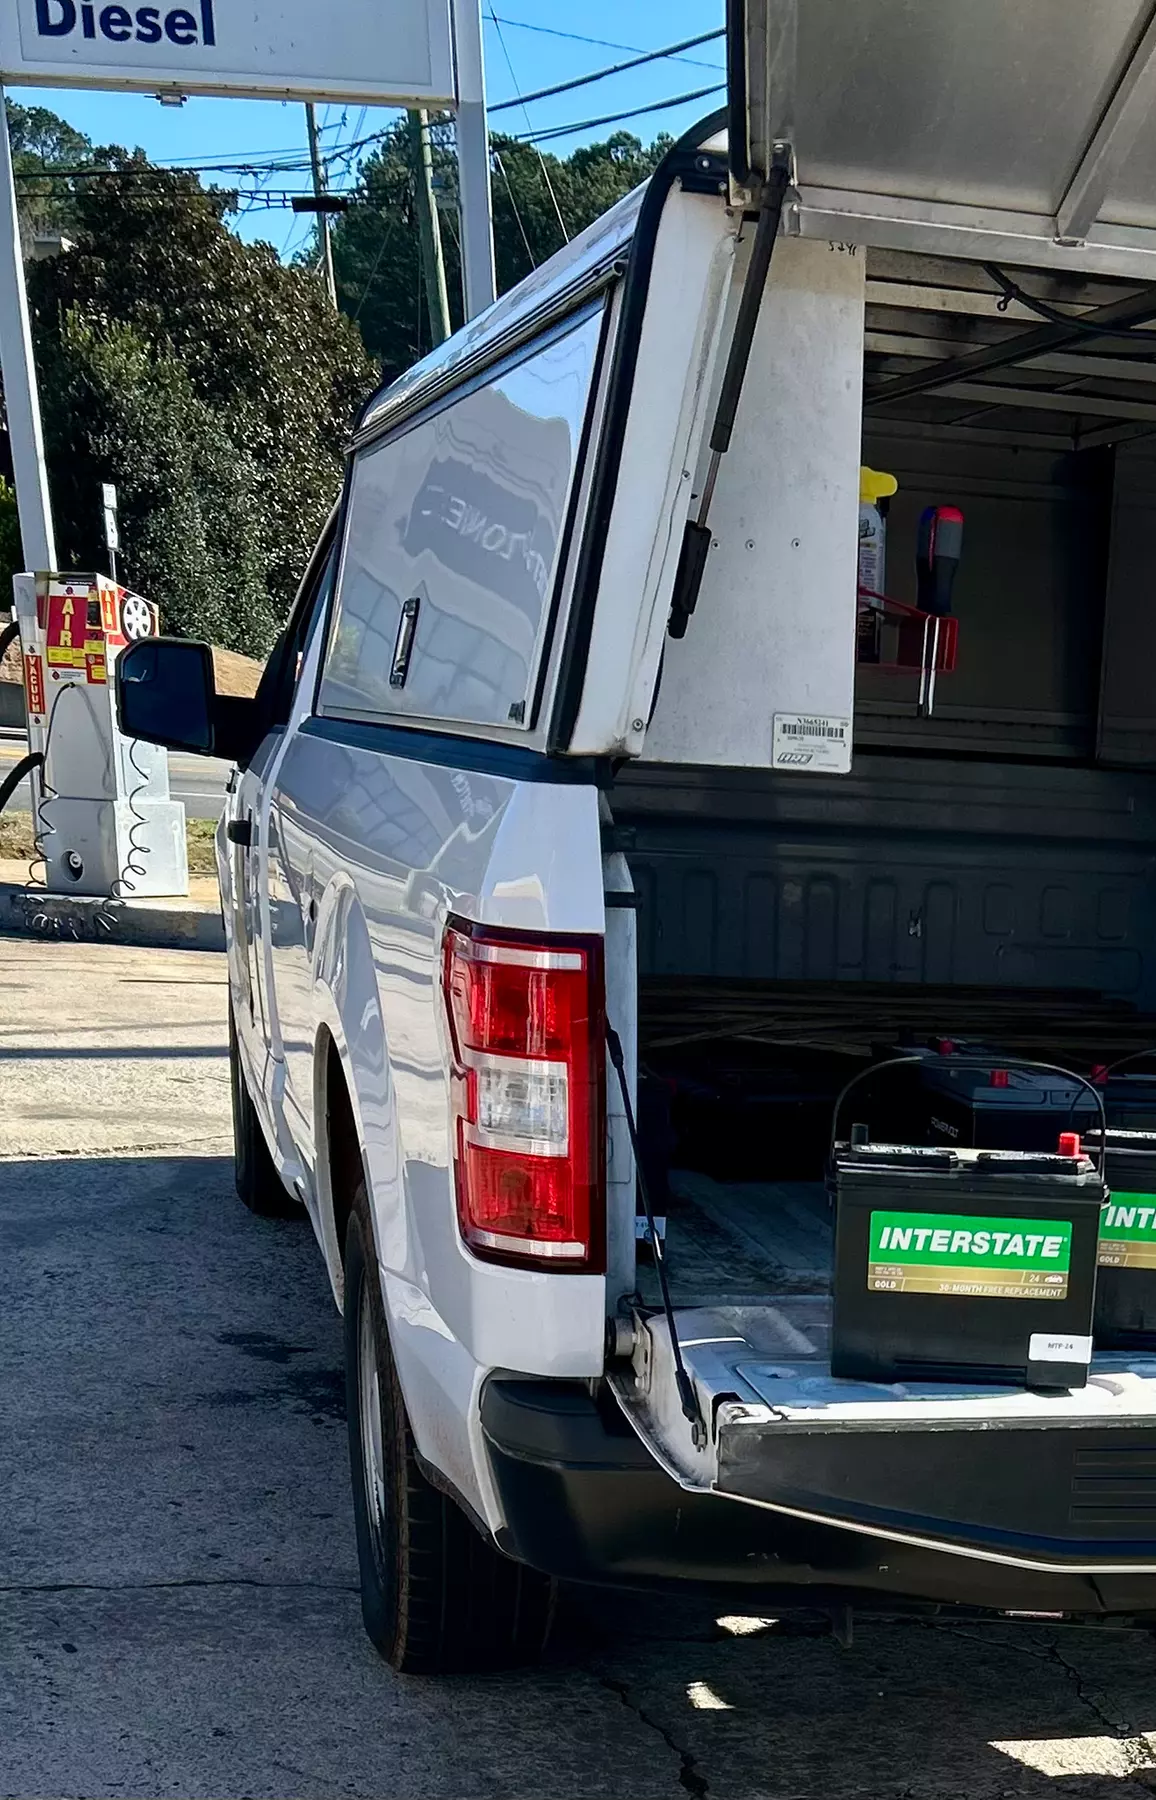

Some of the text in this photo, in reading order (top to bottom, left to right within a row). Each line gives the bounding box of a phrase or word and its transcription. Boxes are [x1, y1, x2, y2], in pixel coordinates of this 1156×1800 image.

[35, 0, 216, 46] Diesel
[60, 598, 74, 647] AIR
[29, 657, 41, 712] VACUUM
[878, 1226, 1063, 1258] INTERSTATE
[1099, 1255, 1120, 1264] GOLD
[874, 1280, 897, 1289] GOLD
[1028, 1273, 1040, 1284] 24
[983, 1285, 1004, 1295] FREE
[1004, 1286, 1062, 1297] REPLACEMENT
